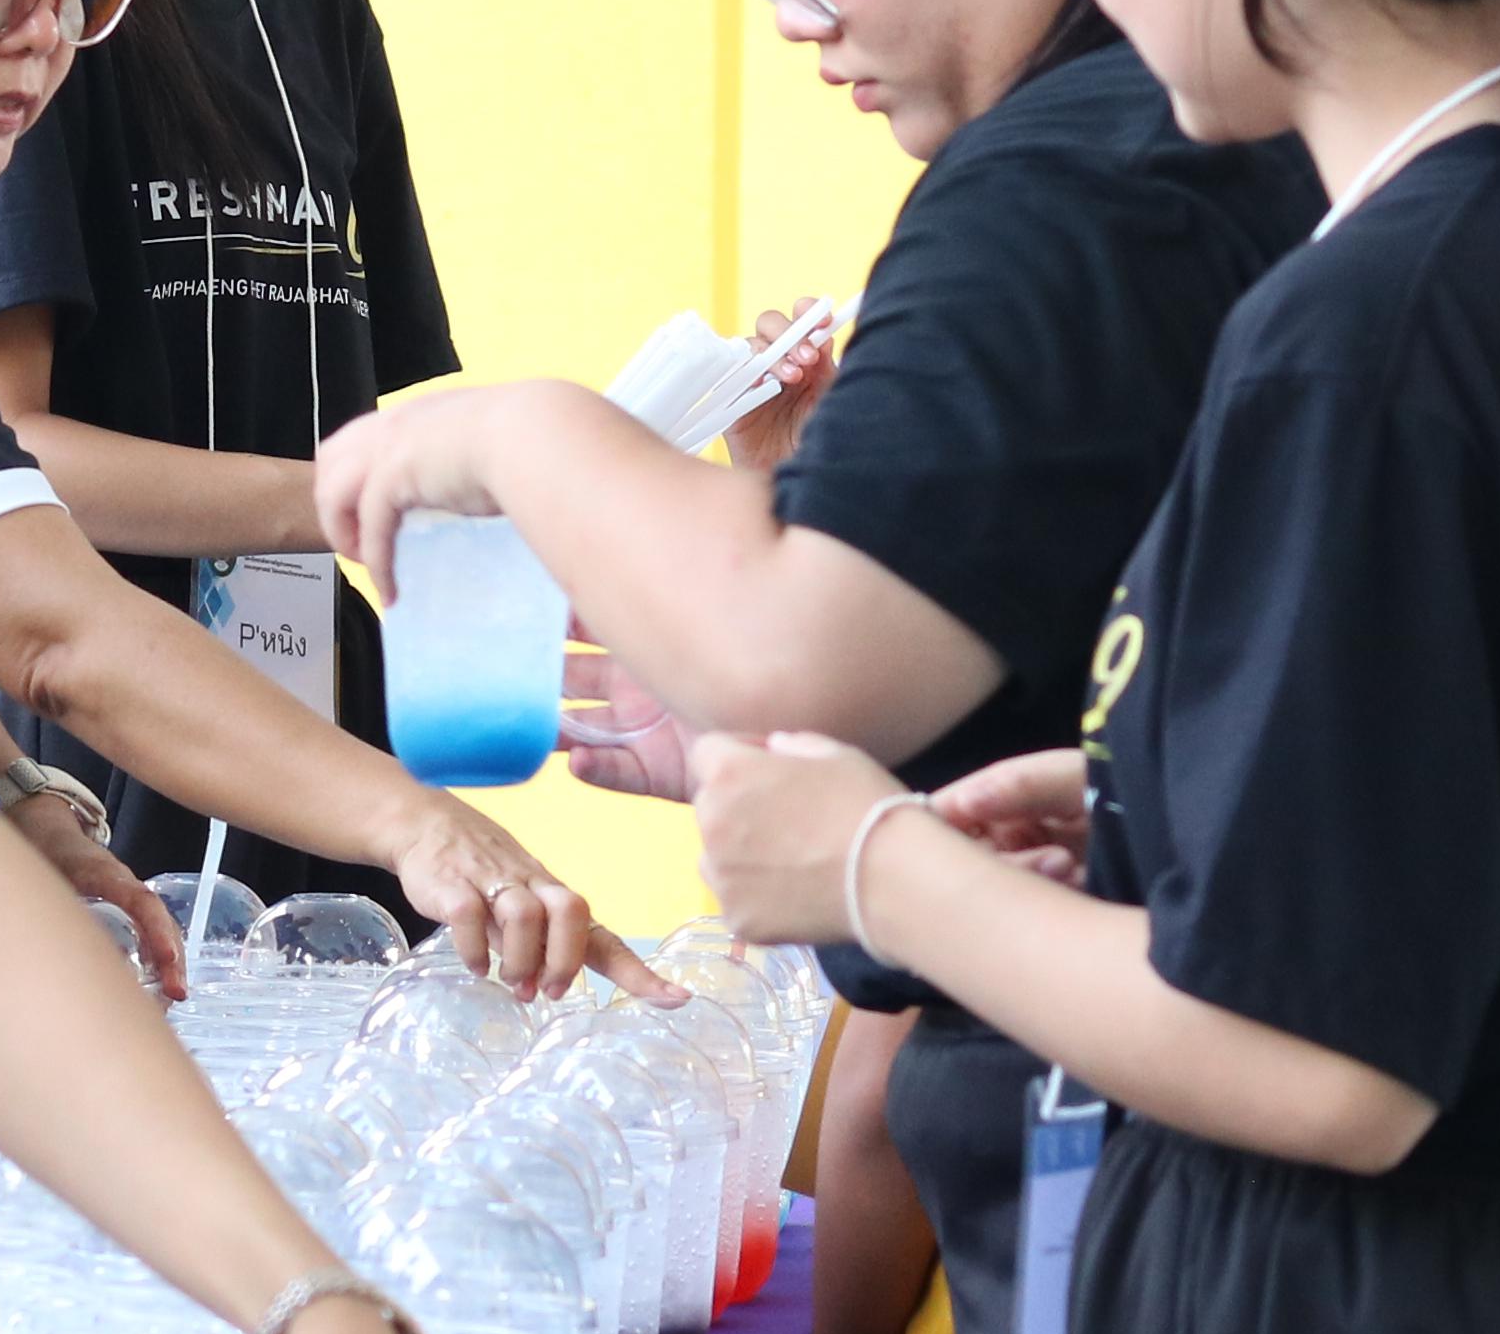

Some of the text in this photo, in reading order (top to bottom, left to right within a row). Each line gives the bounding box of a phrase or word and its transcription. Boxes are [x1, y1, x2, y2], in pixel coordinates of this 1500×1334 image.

[131, 177, 337, 232] RESHMAN
[143, 278, 248, 300] AMPHAENG
[268, 283, 350, 306] RAJABHAT
[239, 622, 307, 658] P'หนิง
